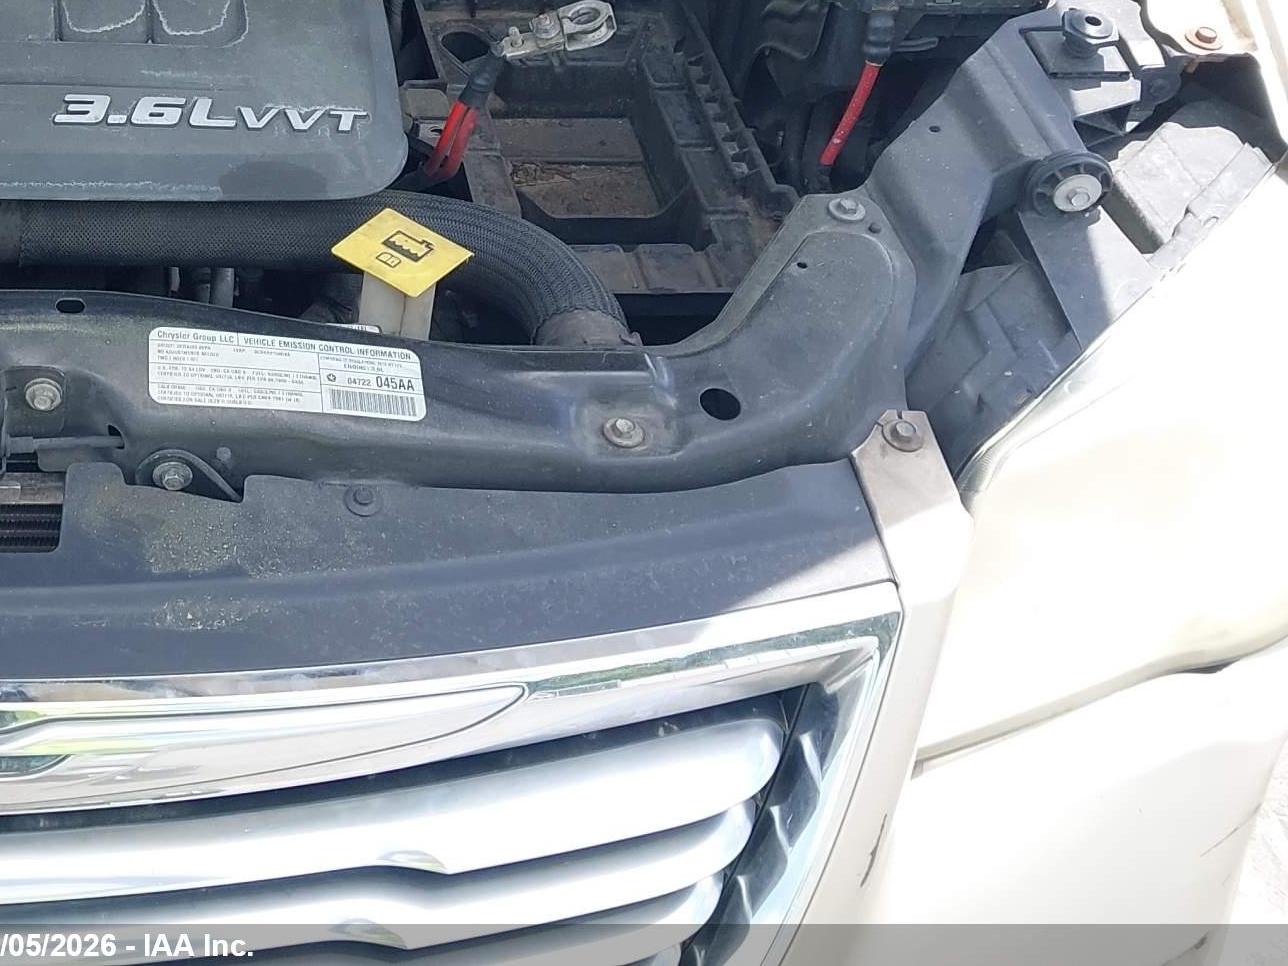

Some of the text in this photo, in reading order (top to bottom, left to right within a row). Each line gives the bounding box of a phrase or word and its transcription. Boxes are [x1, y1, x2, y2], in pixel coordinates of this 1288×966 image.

[157, 330, 234, 343] Chrysler Group LLC
[243, 337, 411, 360] VEHICLE EMISSION CONTROL INFORMATION
[347, 376, 415, 391] 04722 045AA
